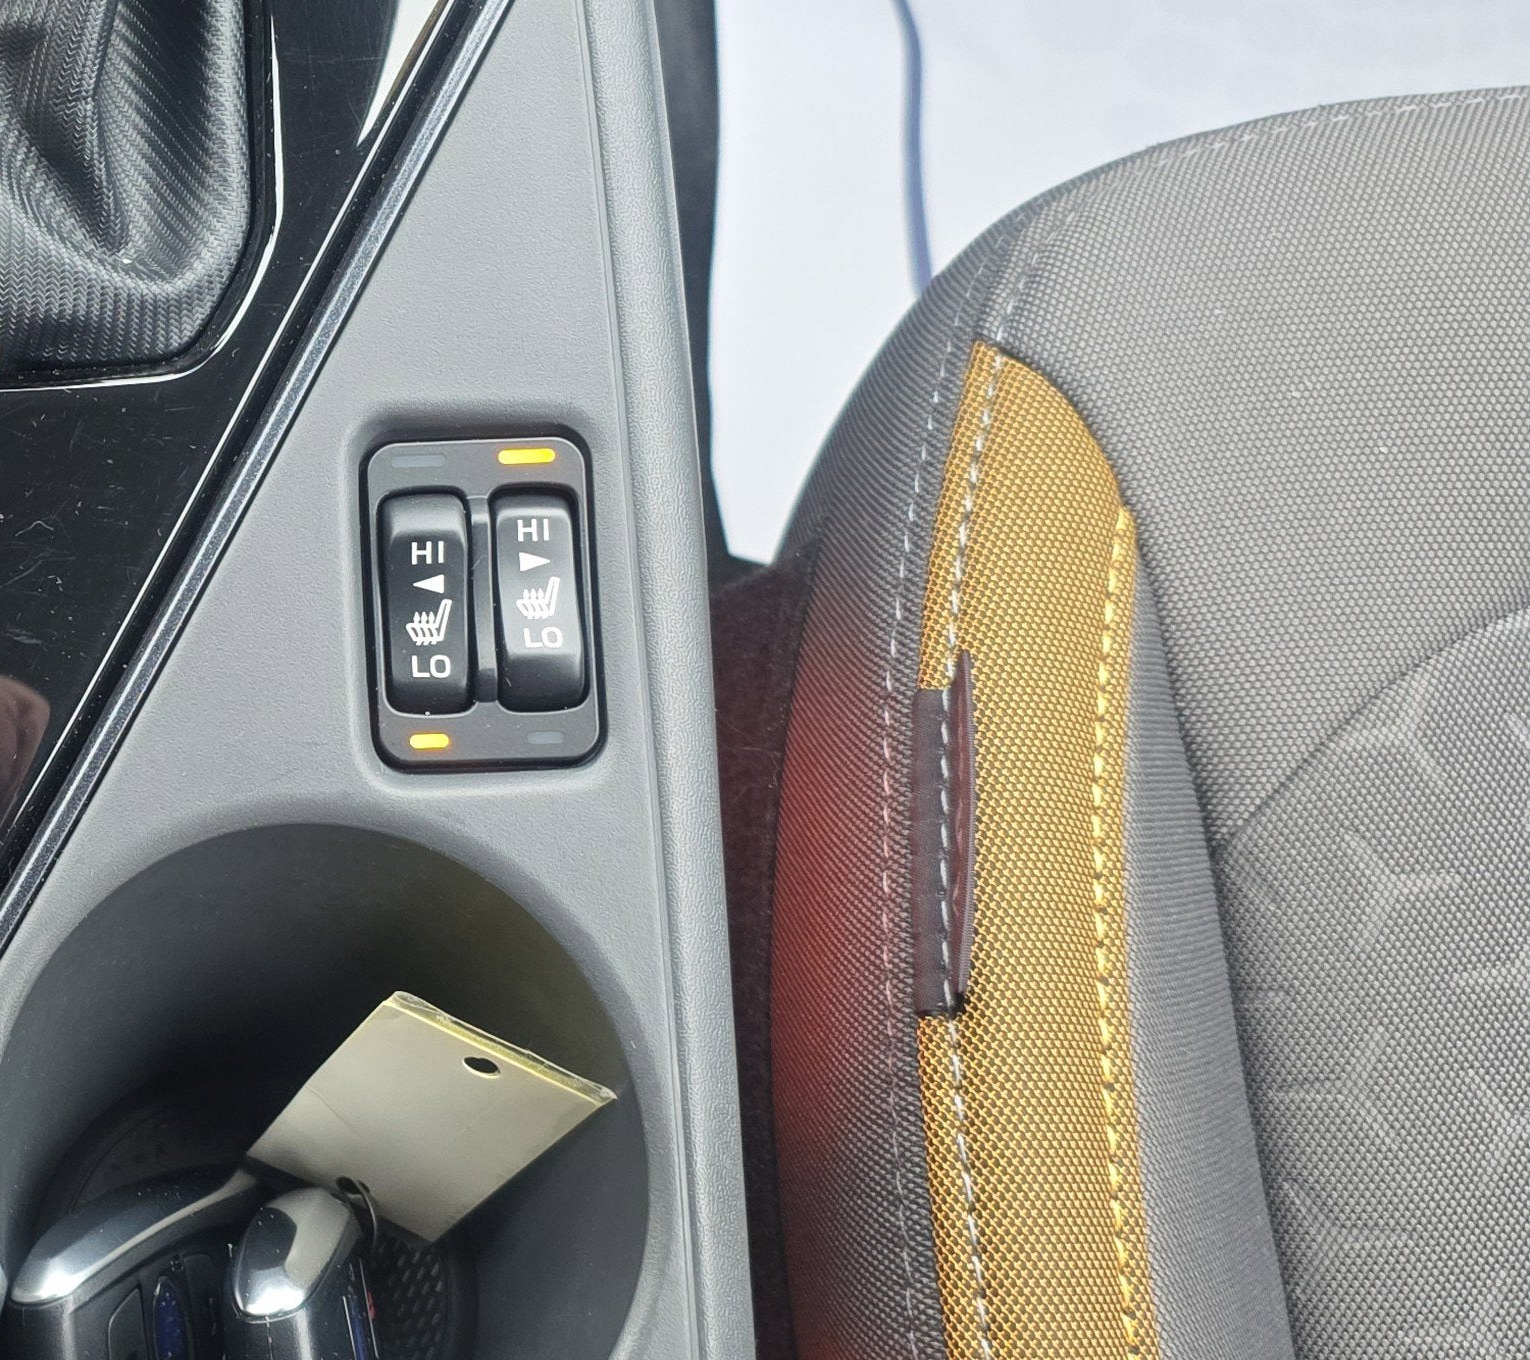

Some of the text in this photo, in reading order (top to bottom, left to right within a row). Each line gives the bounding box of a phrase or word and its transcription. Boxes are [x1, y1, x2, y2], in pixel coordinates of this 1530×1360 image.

[517, 518, 550, 542] HI
[411, 541, 445, 565] HI
[523, 626, 563, 649] LO
[411, 654, 451, 679] LO
